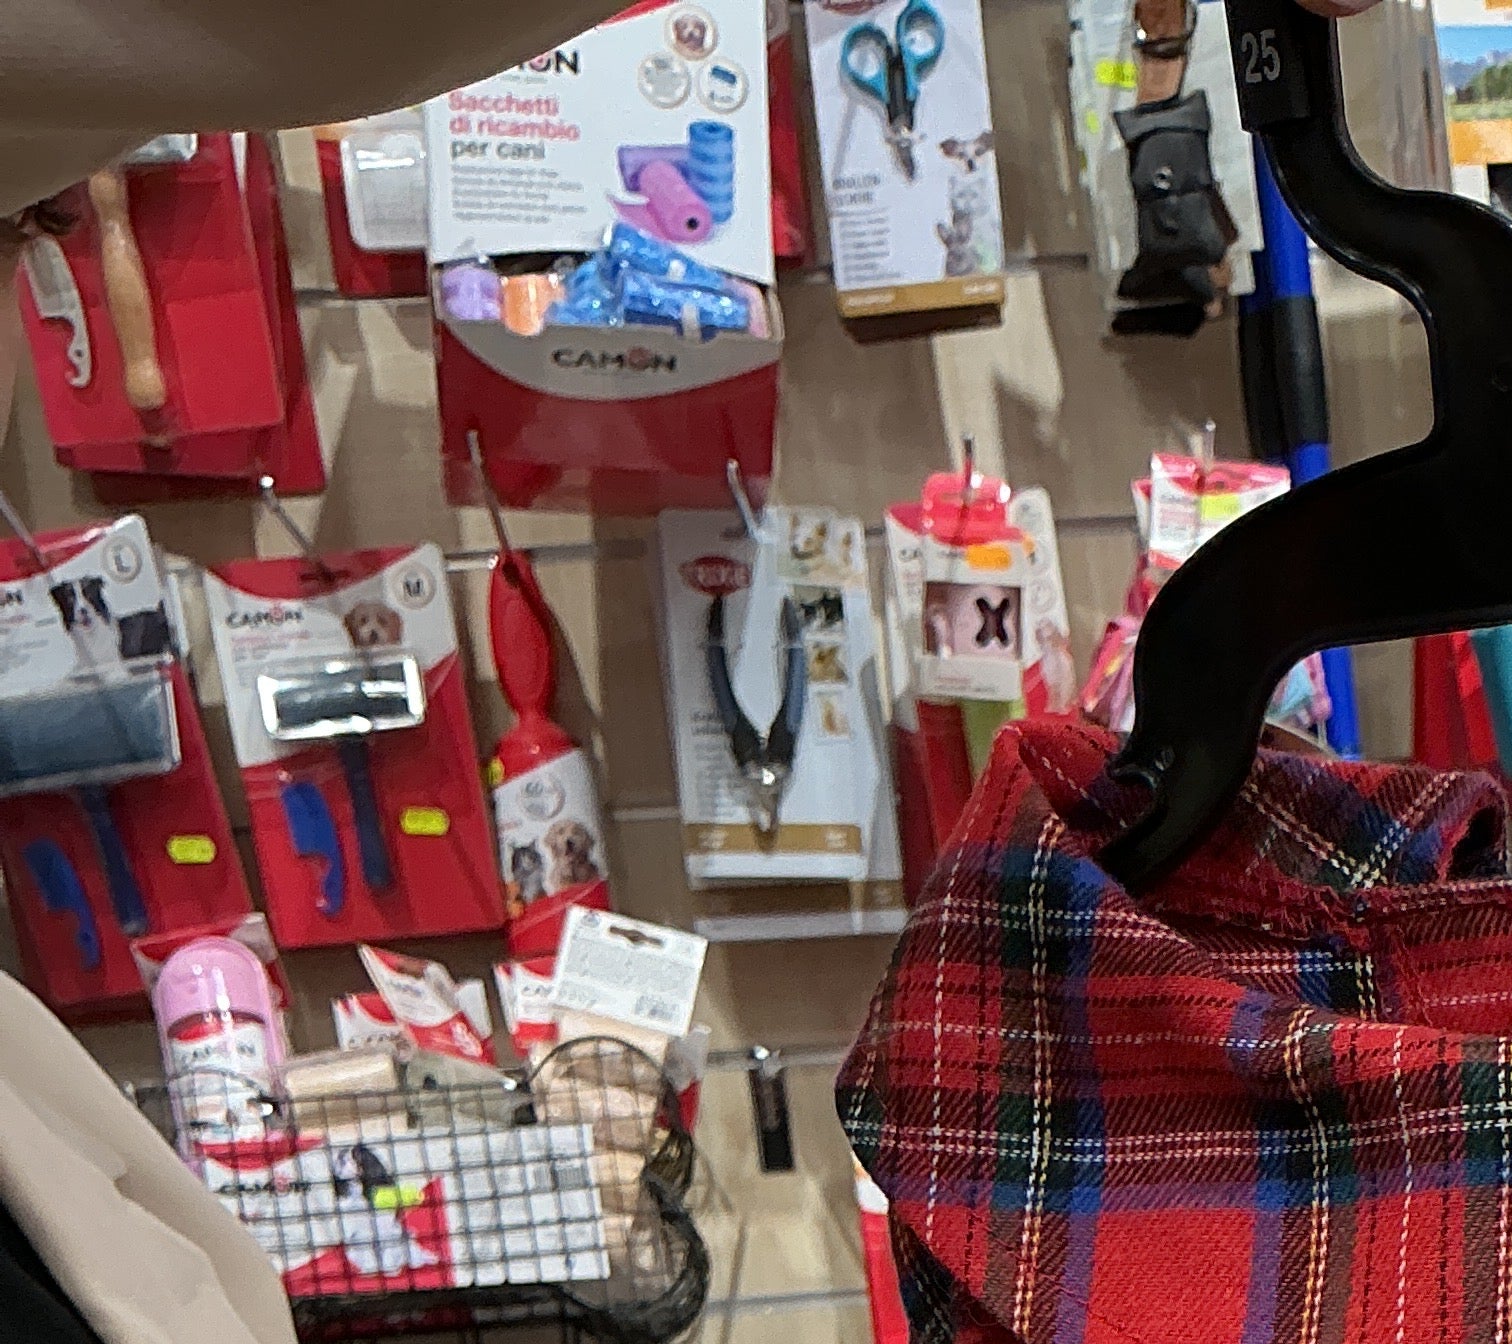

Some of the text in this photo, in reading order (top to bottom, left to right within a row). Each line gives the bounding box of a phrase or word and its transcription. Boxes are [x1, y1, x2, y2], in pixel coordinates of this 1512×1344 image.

[1240, 28, 1281, 83] 25
[448, 115, 581, 142] di ricambio
[451, 140, 546, 161] per cani
[551, 346, 678, 372] CAMON
